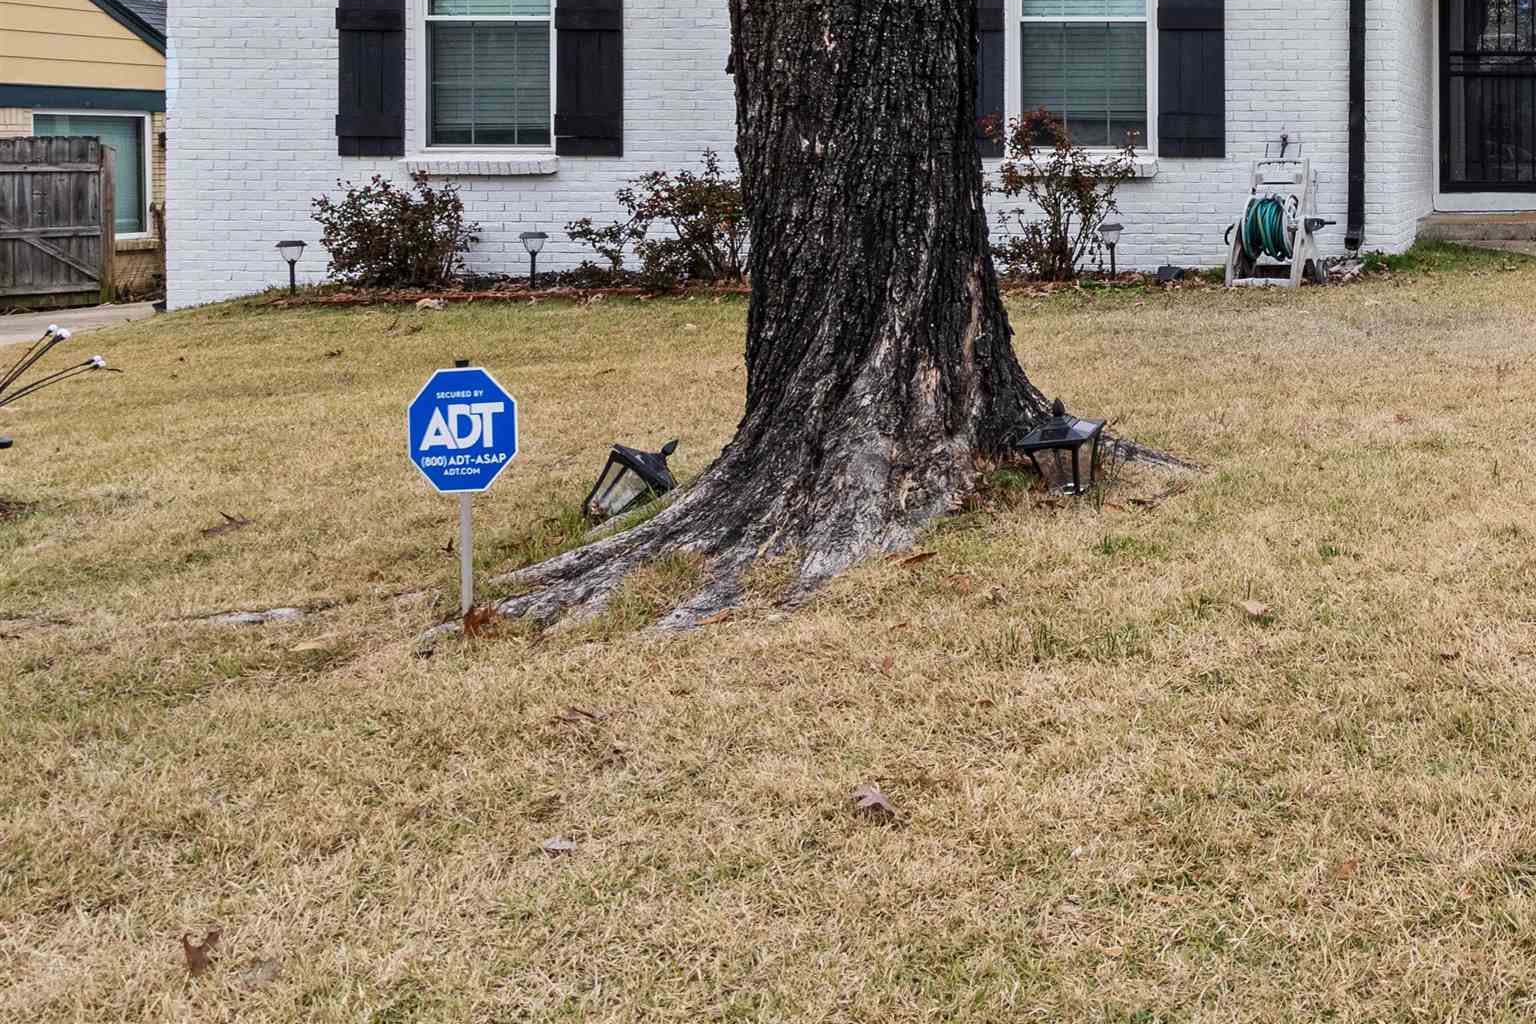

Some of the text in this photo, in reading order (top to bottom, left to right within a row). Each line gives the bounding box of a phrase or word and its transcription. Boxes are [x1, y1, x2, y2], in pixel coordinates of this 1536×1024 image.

[436, 391, 472, 399] SECURED
[419, 402, 504, 451] ADT
[448, 453, 506, 466] ADT-ASAP
